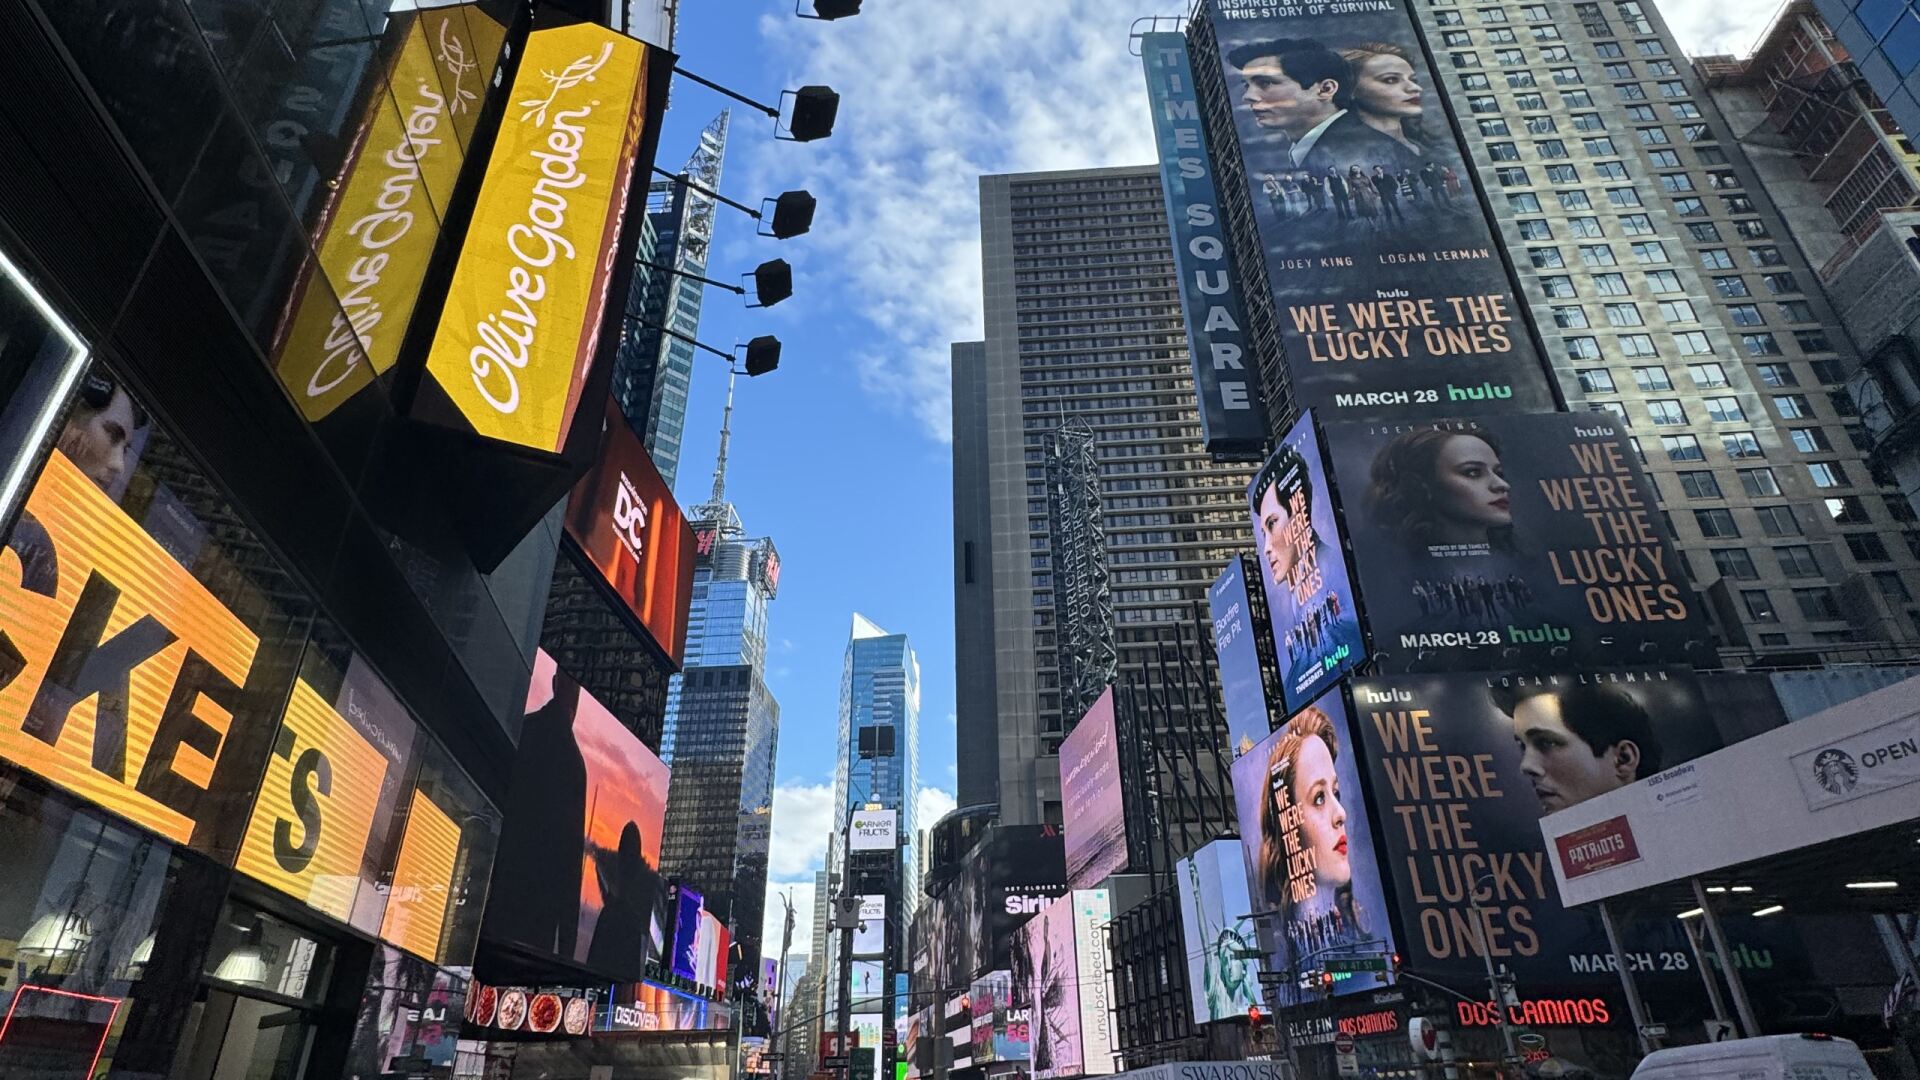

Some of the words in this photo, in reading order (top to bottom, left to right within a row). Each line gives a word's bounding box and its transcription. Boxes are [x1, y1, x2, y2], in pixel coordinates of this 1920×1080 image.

[1223, 9, 1257, 20] TRUE
[1261, 6, 1303, 18] STORY
[1309, 5, 1326, 15] OF
[1331, 1, 1395, 14] SURVIVAL
[1159, 48, 1206, 180] TIMES
[507, 106, 596, 262] Garden
[1280, 259, 1312, 270] JOEY
[1321, 256, 1353, 268] KING
[1379, 252, 1427, 264] LOGAN
[1434, 248, 1490, 261] LERMAN
[1186, 203, 1251, 410] SQUARE
[1377, 289, 1409, 299] hulu
[1289, 304, 1341, 333] WE
[1347, 299, 1440, 330] WERE
[1446, 294, 1512, 325] THE
[471, 265, 548, 414] Olive
[1306, 329, 1409, 362] LUCKY
[1423, 324, 1512, 356] ONES
[1335, 391, 1409, 407] MARCH
[1414, 389, 1439, 403] 28
[1447, 382, 1512, 401] hulu
[1370, 425, 1414, 435] JOEY
[1433, 421, 1478, 432] KING
[1575, 426, 1614, 438] hulu
[1569, 441, 1630, 475] WE
[1288, 485, 1306, 516] WE
[1539, 475, 1645, 511] WERE
[614, 481, 645, 549] DC
[1282, 505, 1310, 547] WERE
[1584, 510, 1659, 545] THE
[1294, 525, 1316, 559] THE
[1287, 546, 1318, 593] LUCKY
[1548, 545, 1668, 585] LUCKY
[1296, 567, 1323, 606] ONES
[1585, 583, 1688, 623] ONES
[1215, 601, 1240, 635] Bonfire
[1218, 632, 1231, 652] Fire
[1231, 618, 1242, 639] Pit
[1507, 623, 1572, 643] hulu
[1400, 631, 1472, 649] MARCH
[1476, 630, 1501, 645] 28
[1324, 643, 1350, 671] hulu
[1366, 687, 1412, 704] hulu
[1486, 674, 1560, 688] LOGAN
[1580, 671, 1668, 685] LERMAN
[1371, 710, 1439, 753] WE
[1861, 737, 1919, 769] OPEN
[1382, 754, 1504, 801] WERE
[1274, 785, 1291, 811] WE
[1278, 801, 1305, 834] WERE
[1393, 803, 1479, 850] THE
[1282, 828, 1301, 856] THE
[1567, 832, 1626, 866] PATRIOTS
[1286, 845, 1318, 880] LUCKY
[1407, 851, 1546, 904] LUCKY
[1291, 873, 1317, 904] ONES
[1420, 905, 1539, 960] ONES
[1090, 917, 1108, 1041] unsubscribed.com
[1569, 952, 1655, 974] MARCH
[1659, 951, 1690, 971] 28
[614, 1006, 661, 1029] DISCOVERY
[1316, 1016, 1333, 1034] FIN
[1457, 1000, 1504, 1026] DOS
[1508, 998, 1610, 1025] CAMINOS
[1182, 1064, 1282, 1080] SWAROVSK
